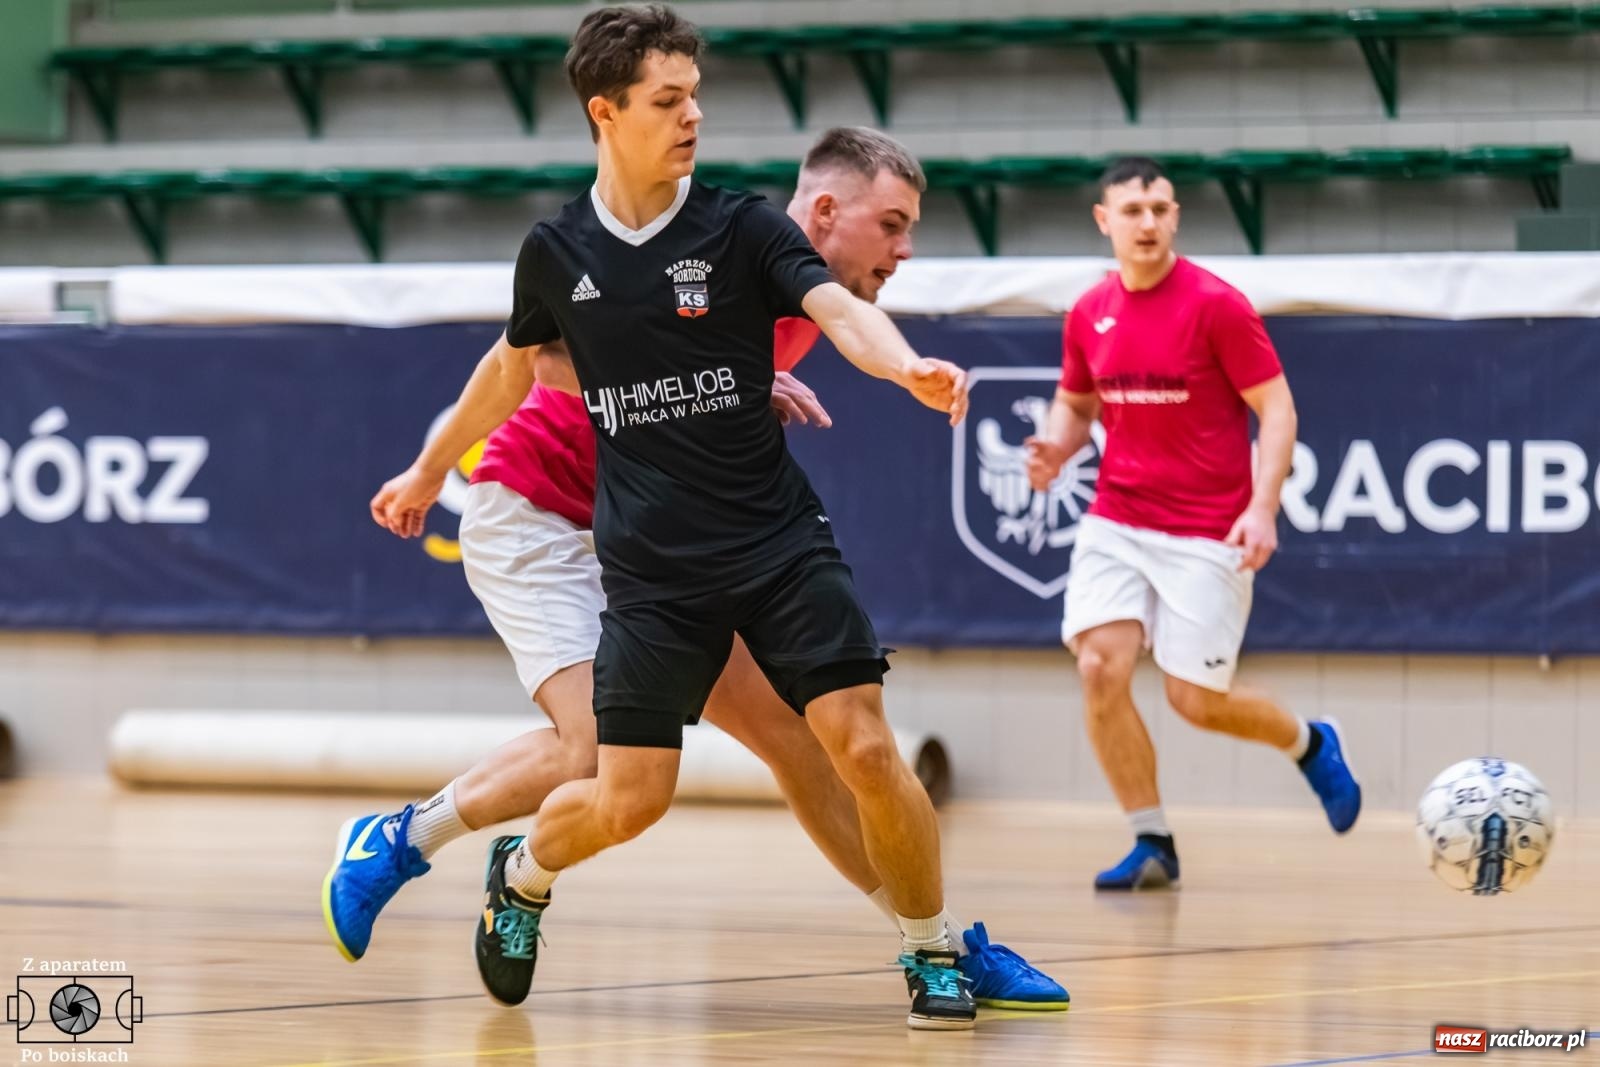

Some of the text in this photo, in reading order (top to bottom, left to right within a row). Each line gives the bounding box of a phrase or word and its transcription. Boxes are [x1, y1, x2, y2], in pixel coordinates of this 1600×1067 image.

[664, 259, 713, 277] NAPRZÓD
[673, 267, 706, 283] BORUCIN
[571, 287, 601, 302] adidas
[678, 292, 706, 307] KS
[627, 393, 740, 426] PRACA W AUSTRII
[0, 405, 210, 525] ÓRZ
[1252, 438, 1600, 534] RACIB
